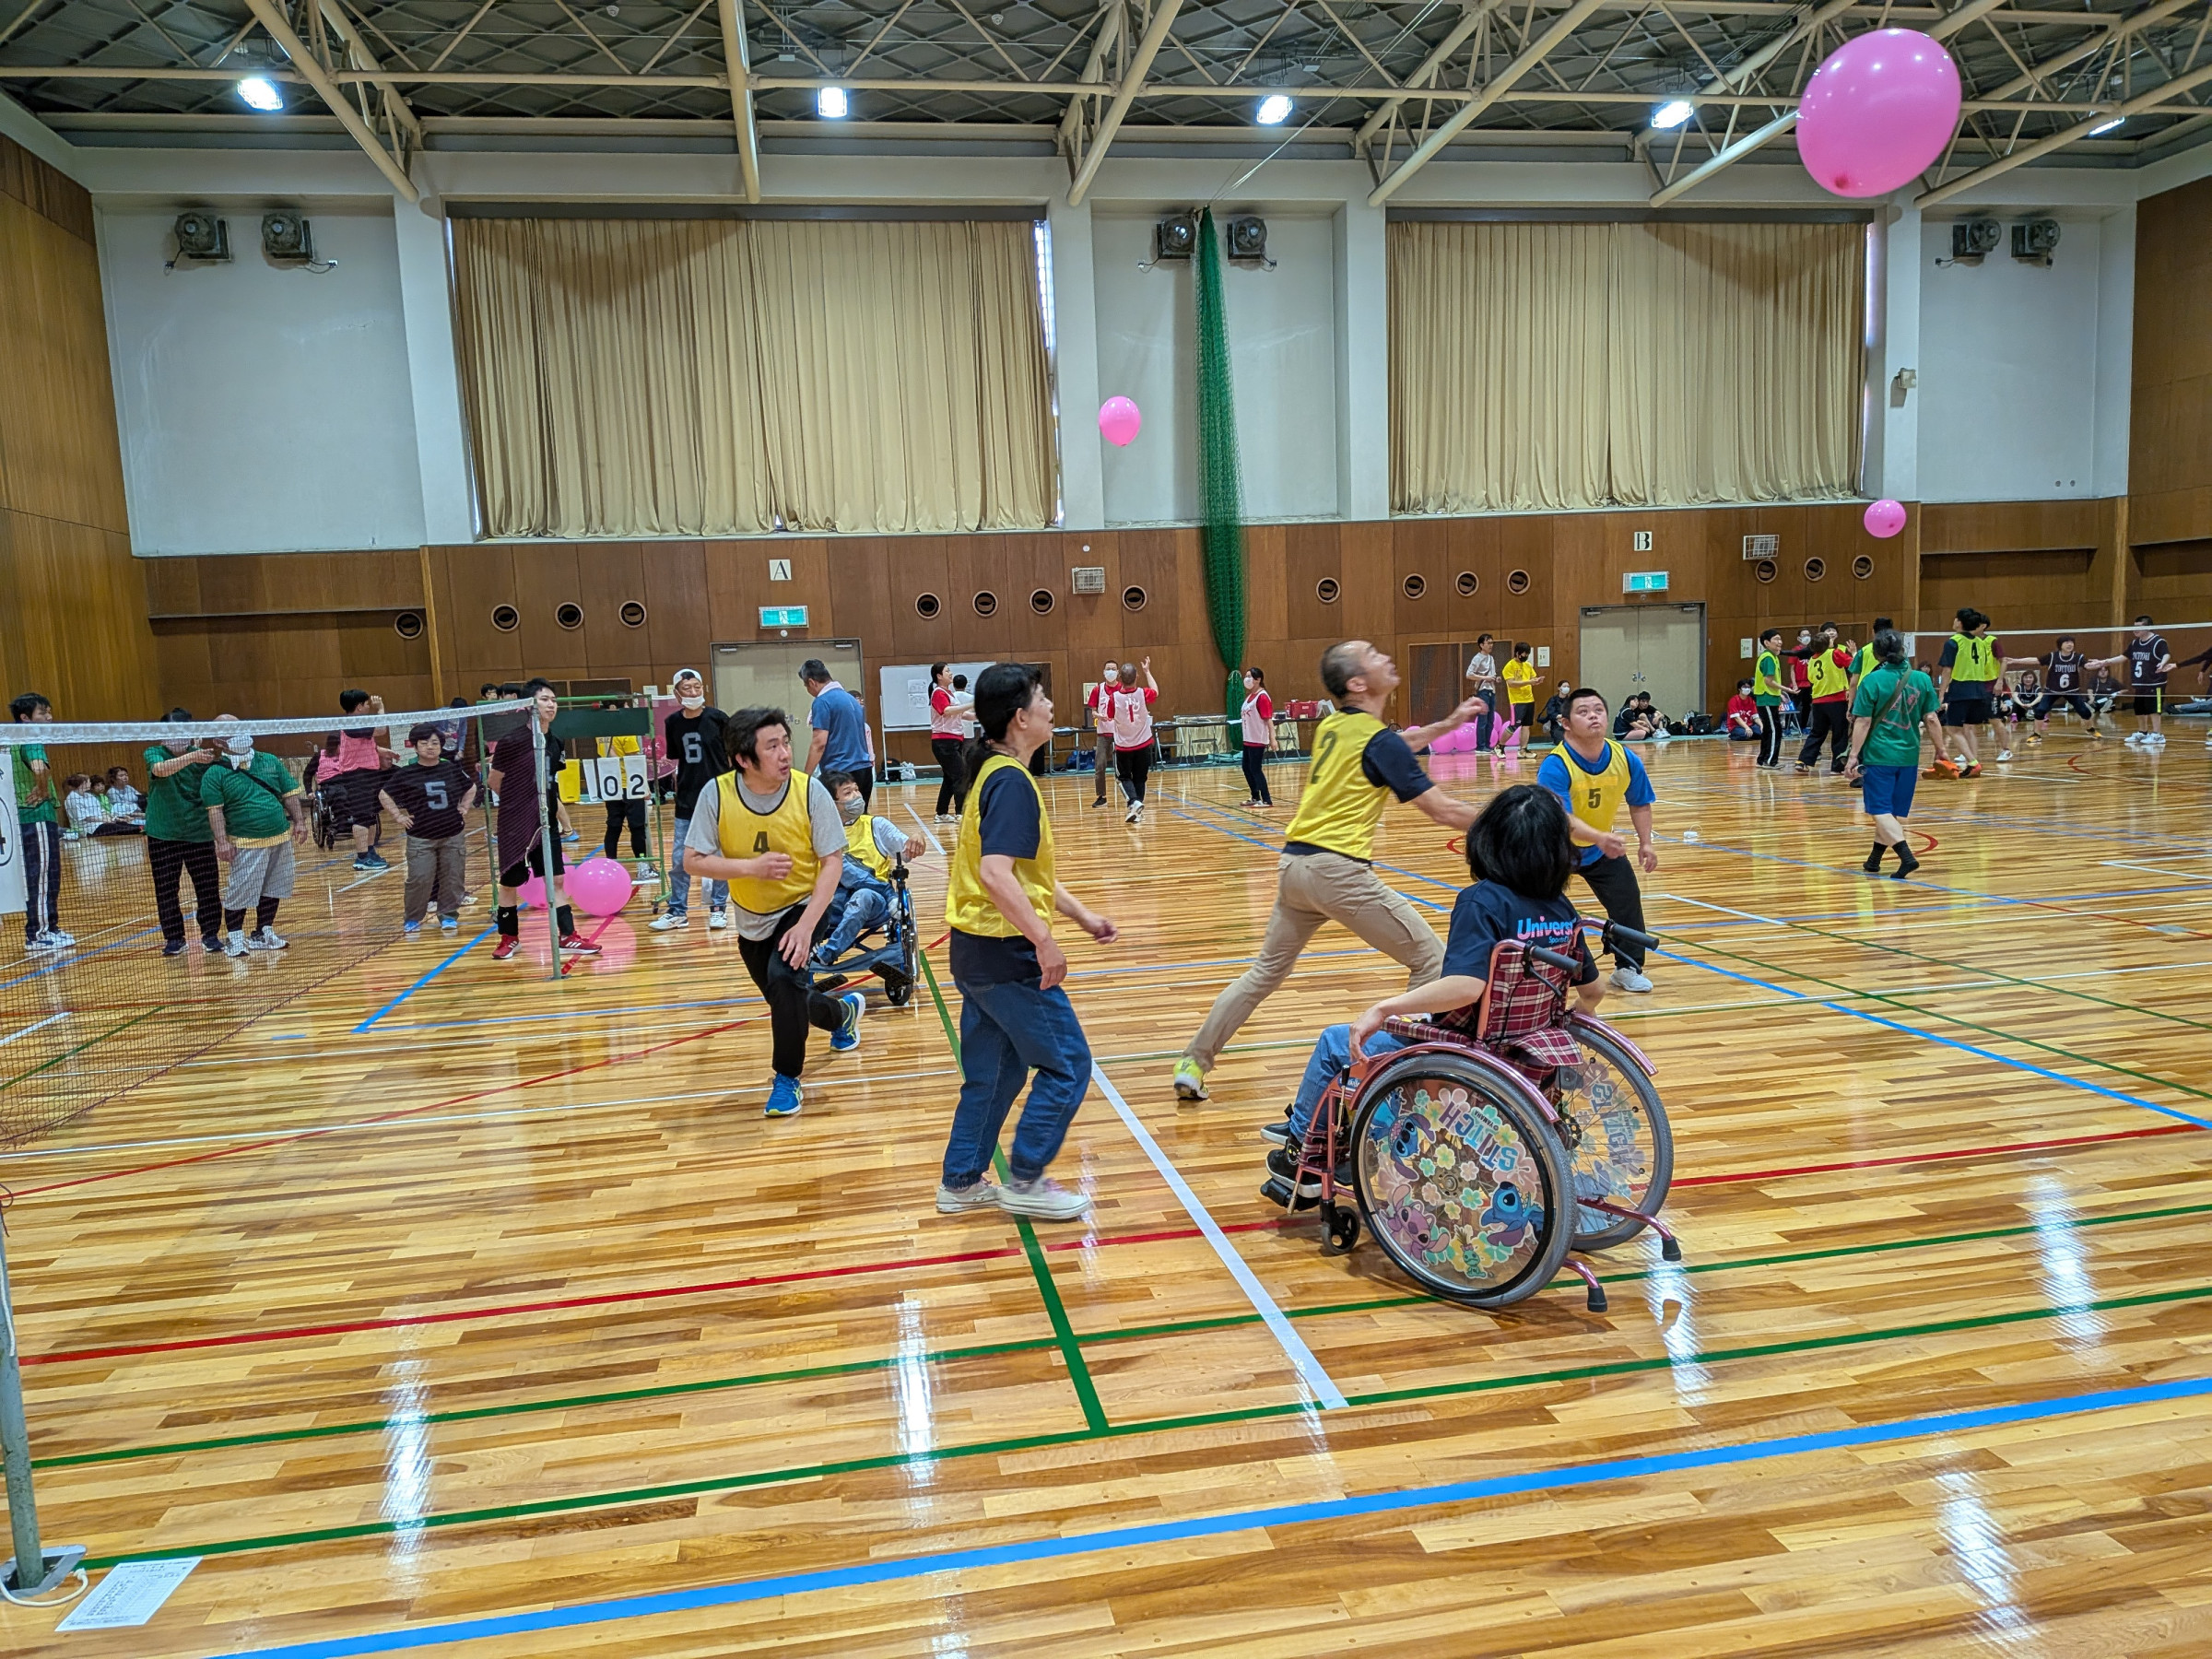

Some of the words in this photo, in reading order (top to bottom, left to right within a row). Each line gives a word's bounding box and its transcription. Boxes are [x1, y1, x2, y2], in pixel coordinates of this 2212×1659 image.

[1636, 533, 1650, 550] B
[773, 560, 789, 580] A
[1971, 641, 1980, 665] 4
[1814, 659, 1824, 680] 3
[2134, 661, 2143, 677] 5
[2059, 674, 2070, 688] 6
[682, 732, 702, 764] 6
[1311, 730, 1338, 784] 2
[424, 781, 449, 810] 5
[1588, 787, 1602, 809] 5
[752, 830, 771, 854] 4
[1474, 1109, 1494, 1130] YAMAHA
[1438, 1100, 1519, 1171] STITCH
